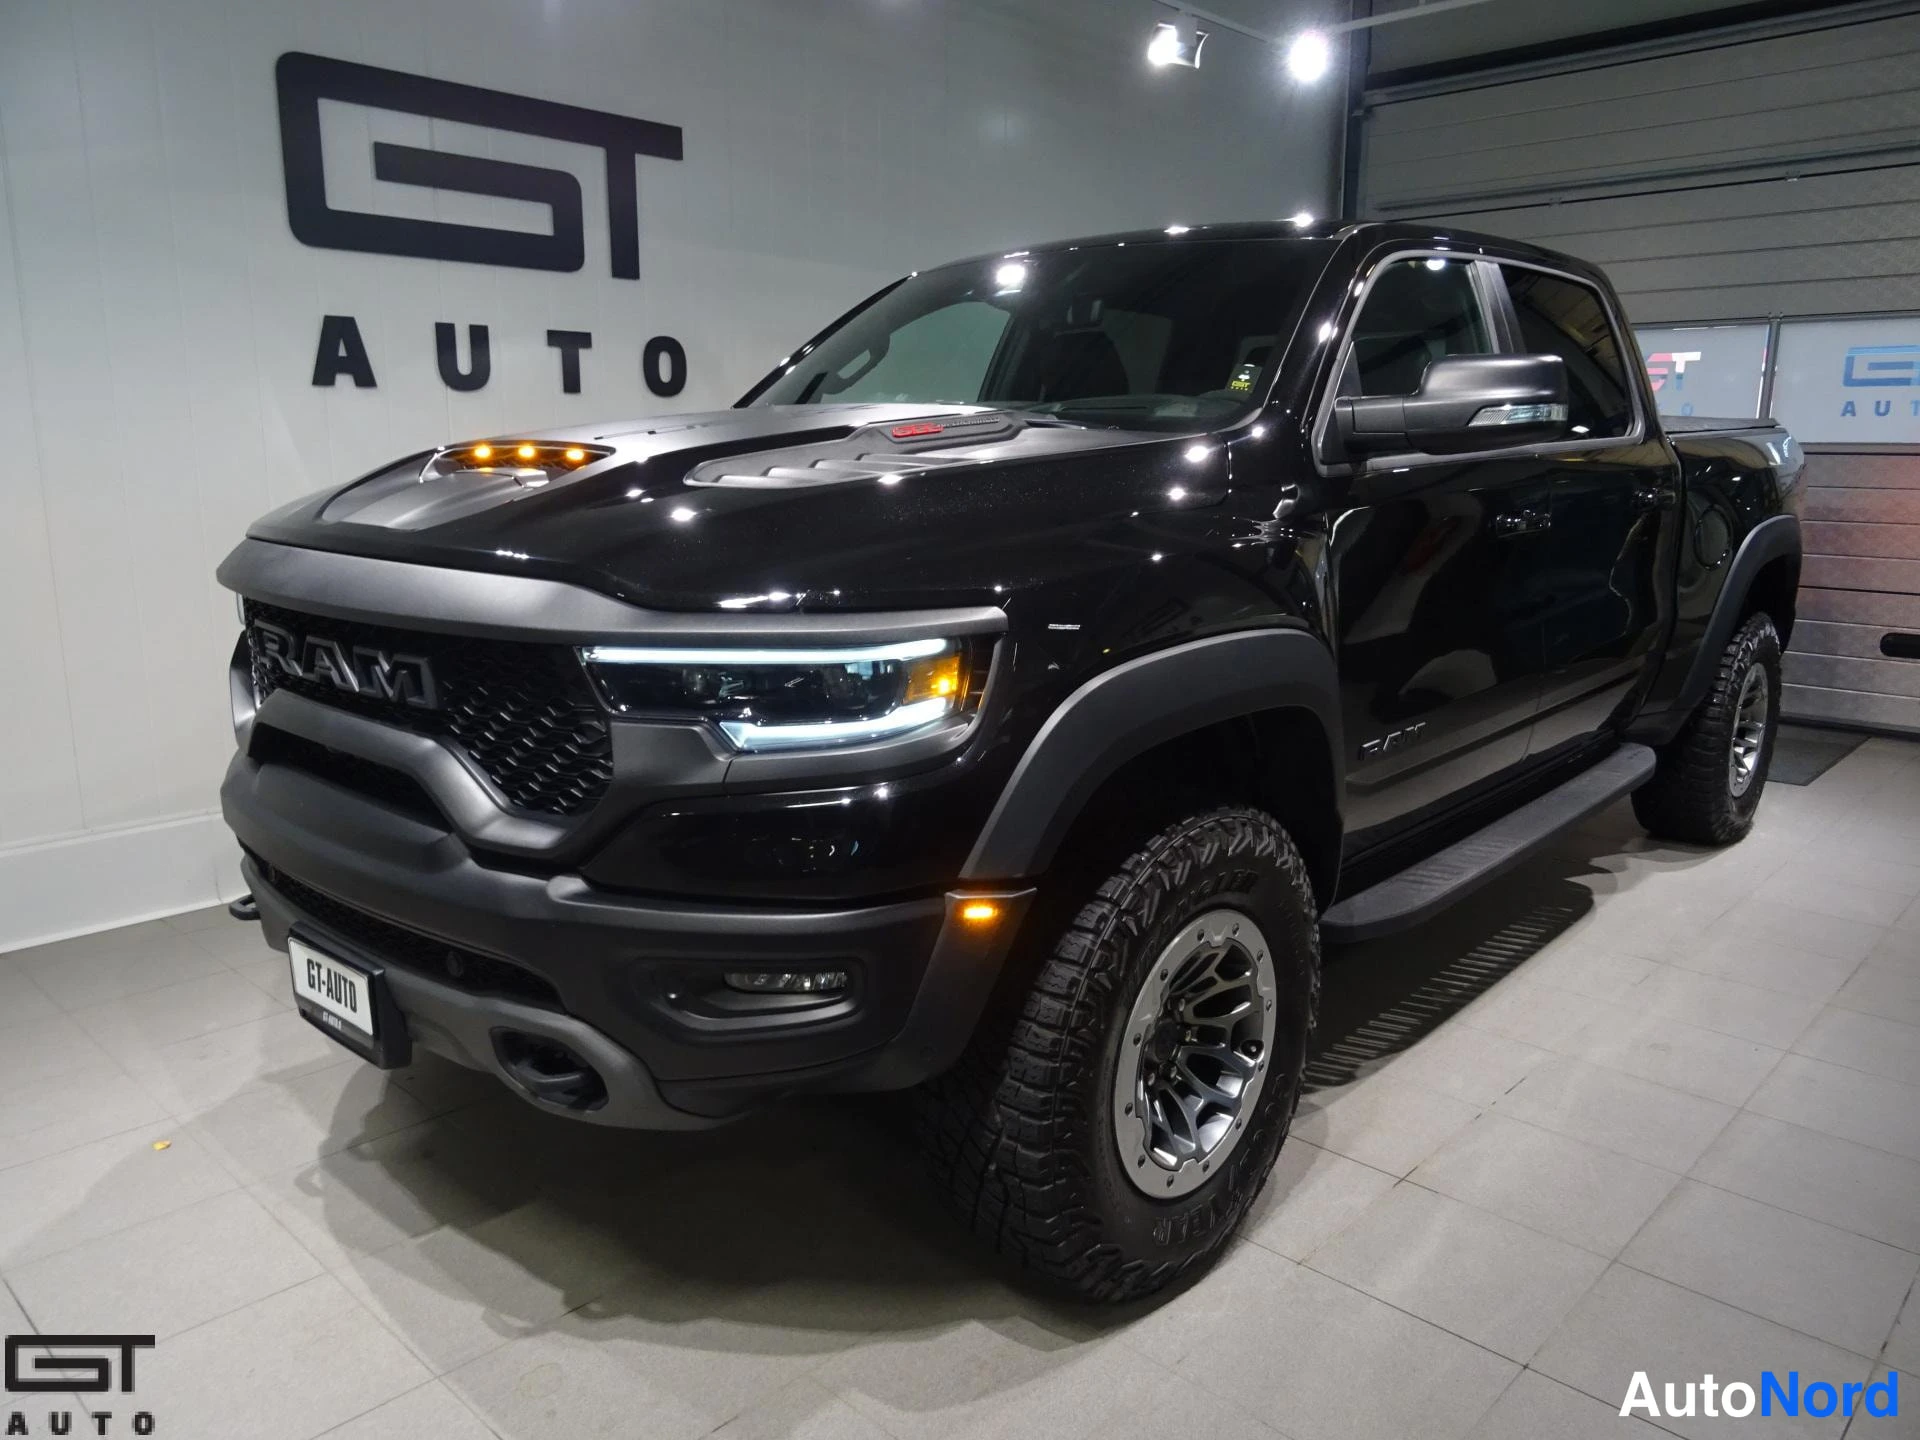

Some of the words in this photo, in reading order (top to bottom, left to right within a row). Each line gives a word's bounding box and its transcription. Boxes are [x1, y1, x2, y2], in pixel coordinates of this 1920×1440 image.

[276, 51, 684, 280] GT
[312, 315, 688, 397] AUTO
[1840, 400, 1920, 417] AUT
[253, 618, 437, 709] RAM
[306, 958, 358, 1014] GT-AUTO
